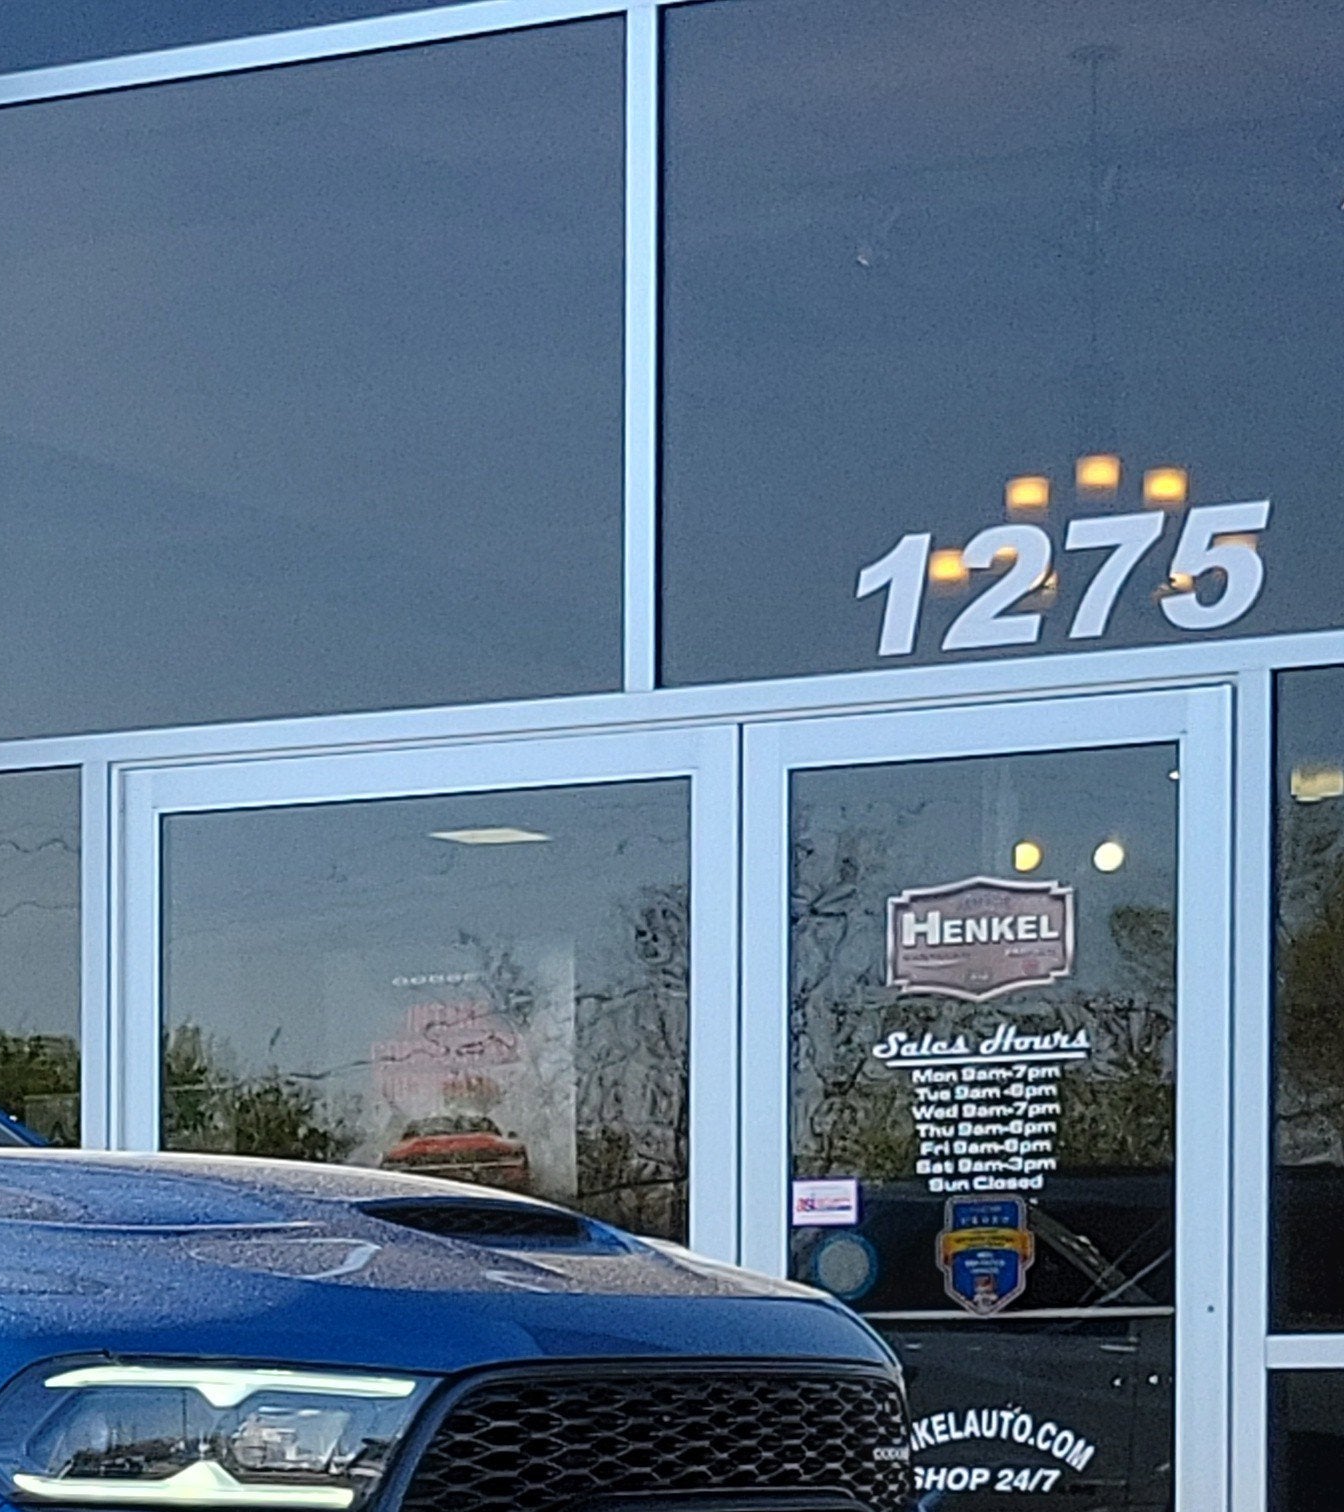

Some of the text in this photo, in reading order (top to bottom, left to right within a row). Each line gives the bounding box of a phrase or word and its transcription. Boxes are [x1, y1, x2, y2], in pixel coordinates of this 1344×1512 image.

[855, 500, 1271, 657] 1275
[901, 910, 1060, 947] HENKEL
[872, 1023, 1091, 1058] Sales Hours
[912, 1069, 958, 1084] Mon
[914, 1086, 952, 1102] Tue
[912, 1103, 959, 1121] Wed
[914, 1122, 955, 1139] Thu
[920, 1140, 950, 1156] Fri
[915, 1158, 955, 1175] Sat
[927, 1173, 1044, 1193] Sun Closed
[913, 1466, 1062, 1492] SHOP 24/7
